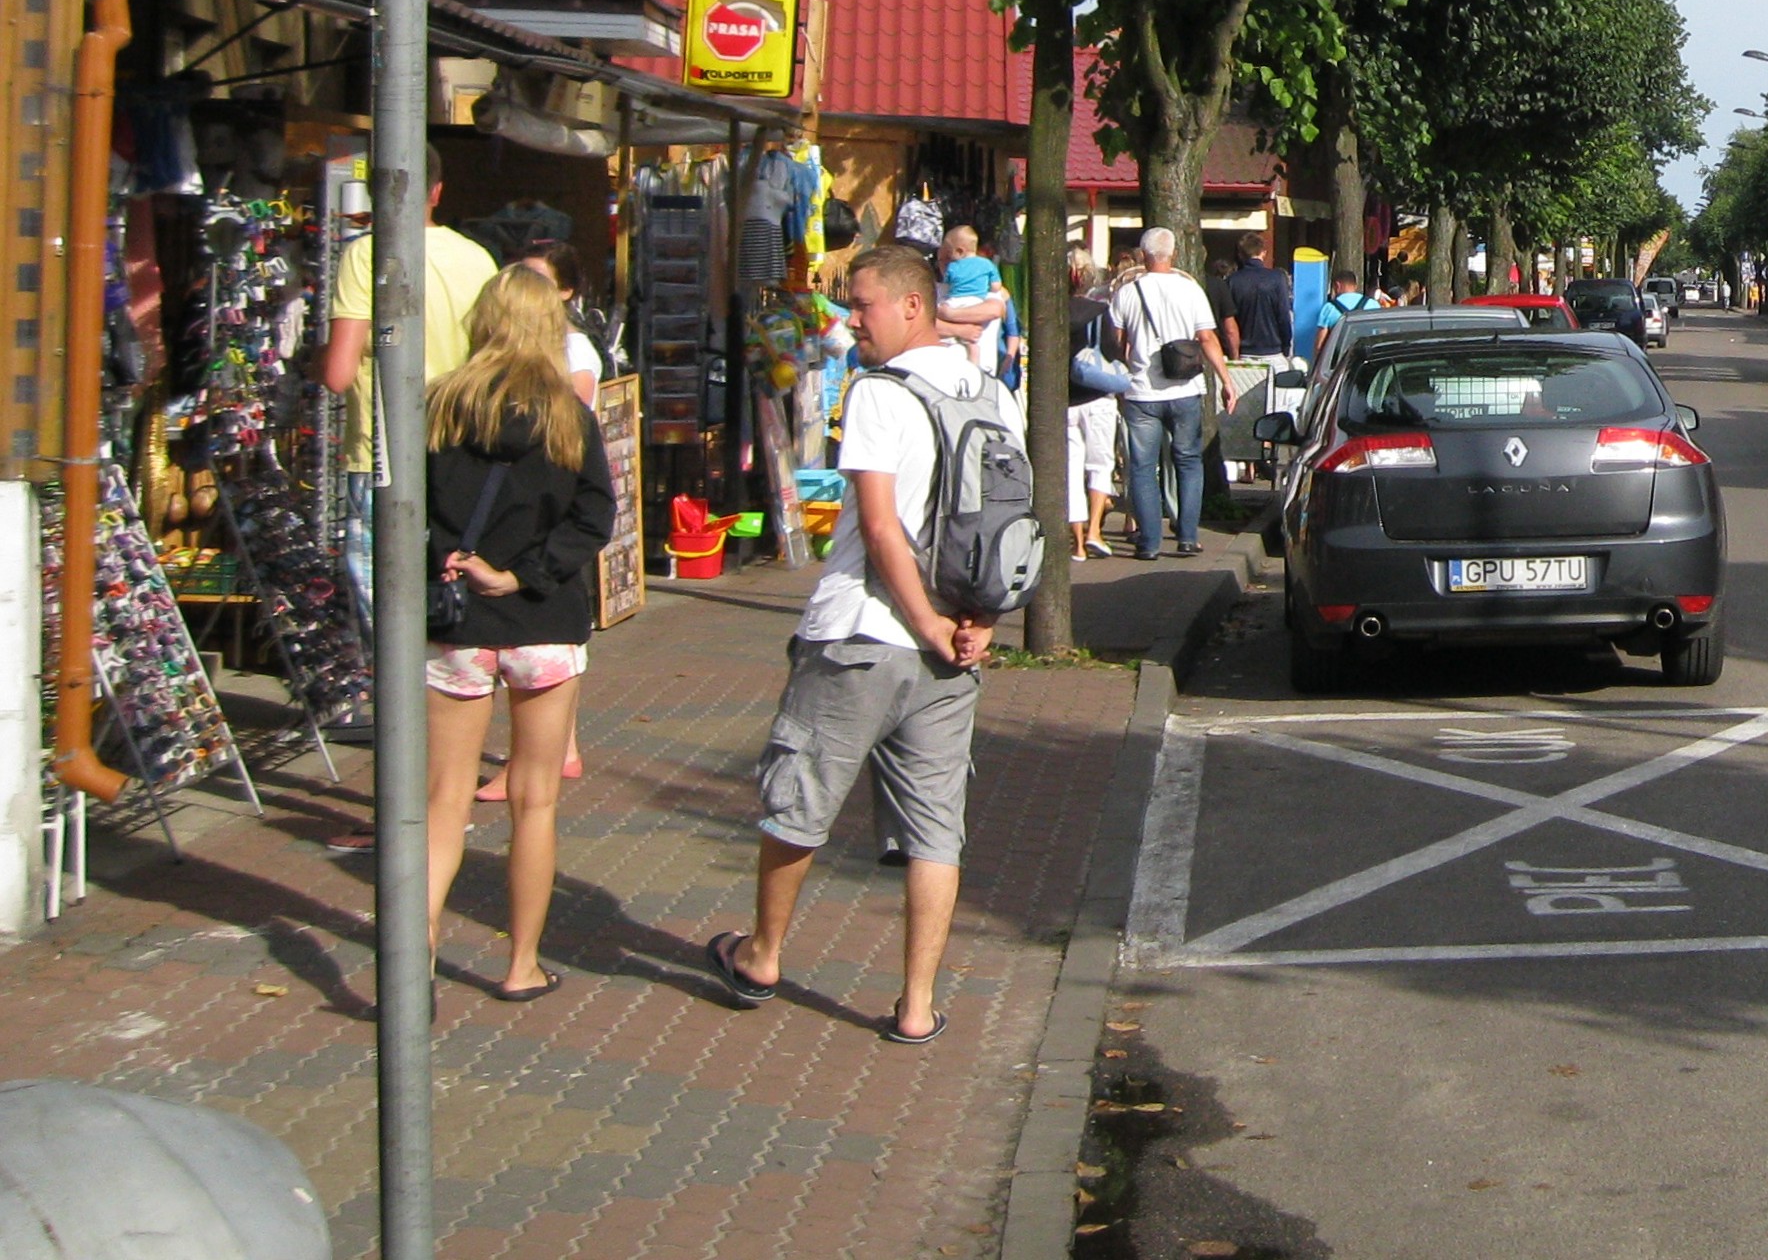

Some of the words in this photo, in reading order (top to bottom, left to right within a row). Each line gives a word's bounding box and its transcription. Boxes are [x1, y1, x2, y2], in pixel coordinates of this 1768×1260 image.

[708, 21, 760, 37] PRASA
[700, 68, 773, 81] KOLPORTER
[1467, 483, 1570, 495] LAGUNA
[1466, 560, 1515, 583] GPU
[1526, 559, 1582, 582] 57TU
